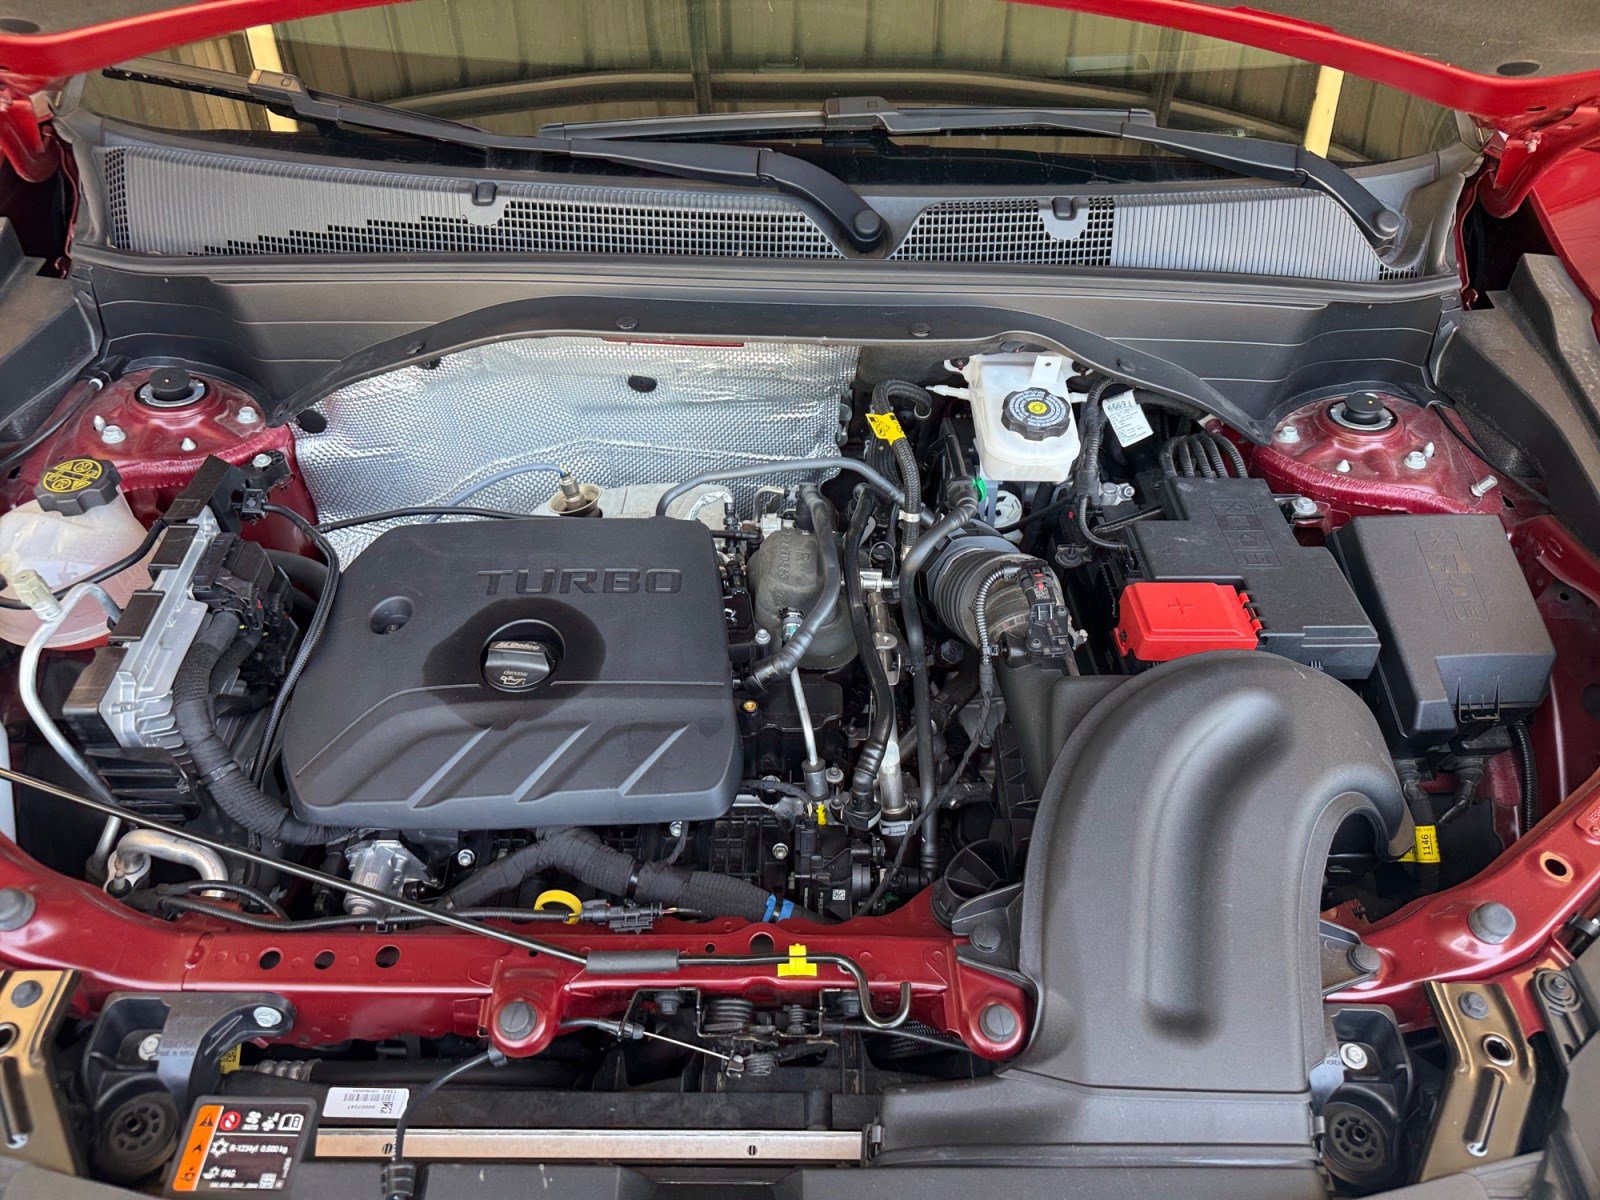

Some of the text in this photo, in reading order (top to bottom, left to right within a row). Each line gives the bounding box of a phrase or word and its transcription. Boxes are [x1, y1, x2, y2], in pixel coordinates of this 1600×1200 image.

[477, 568, 682, 596] TURBO
[494, 641, 541, 651] ACDelco
[1421, 834, 1431, 856] 1146
[229, 1144, 259, 1154] R-1234yf
